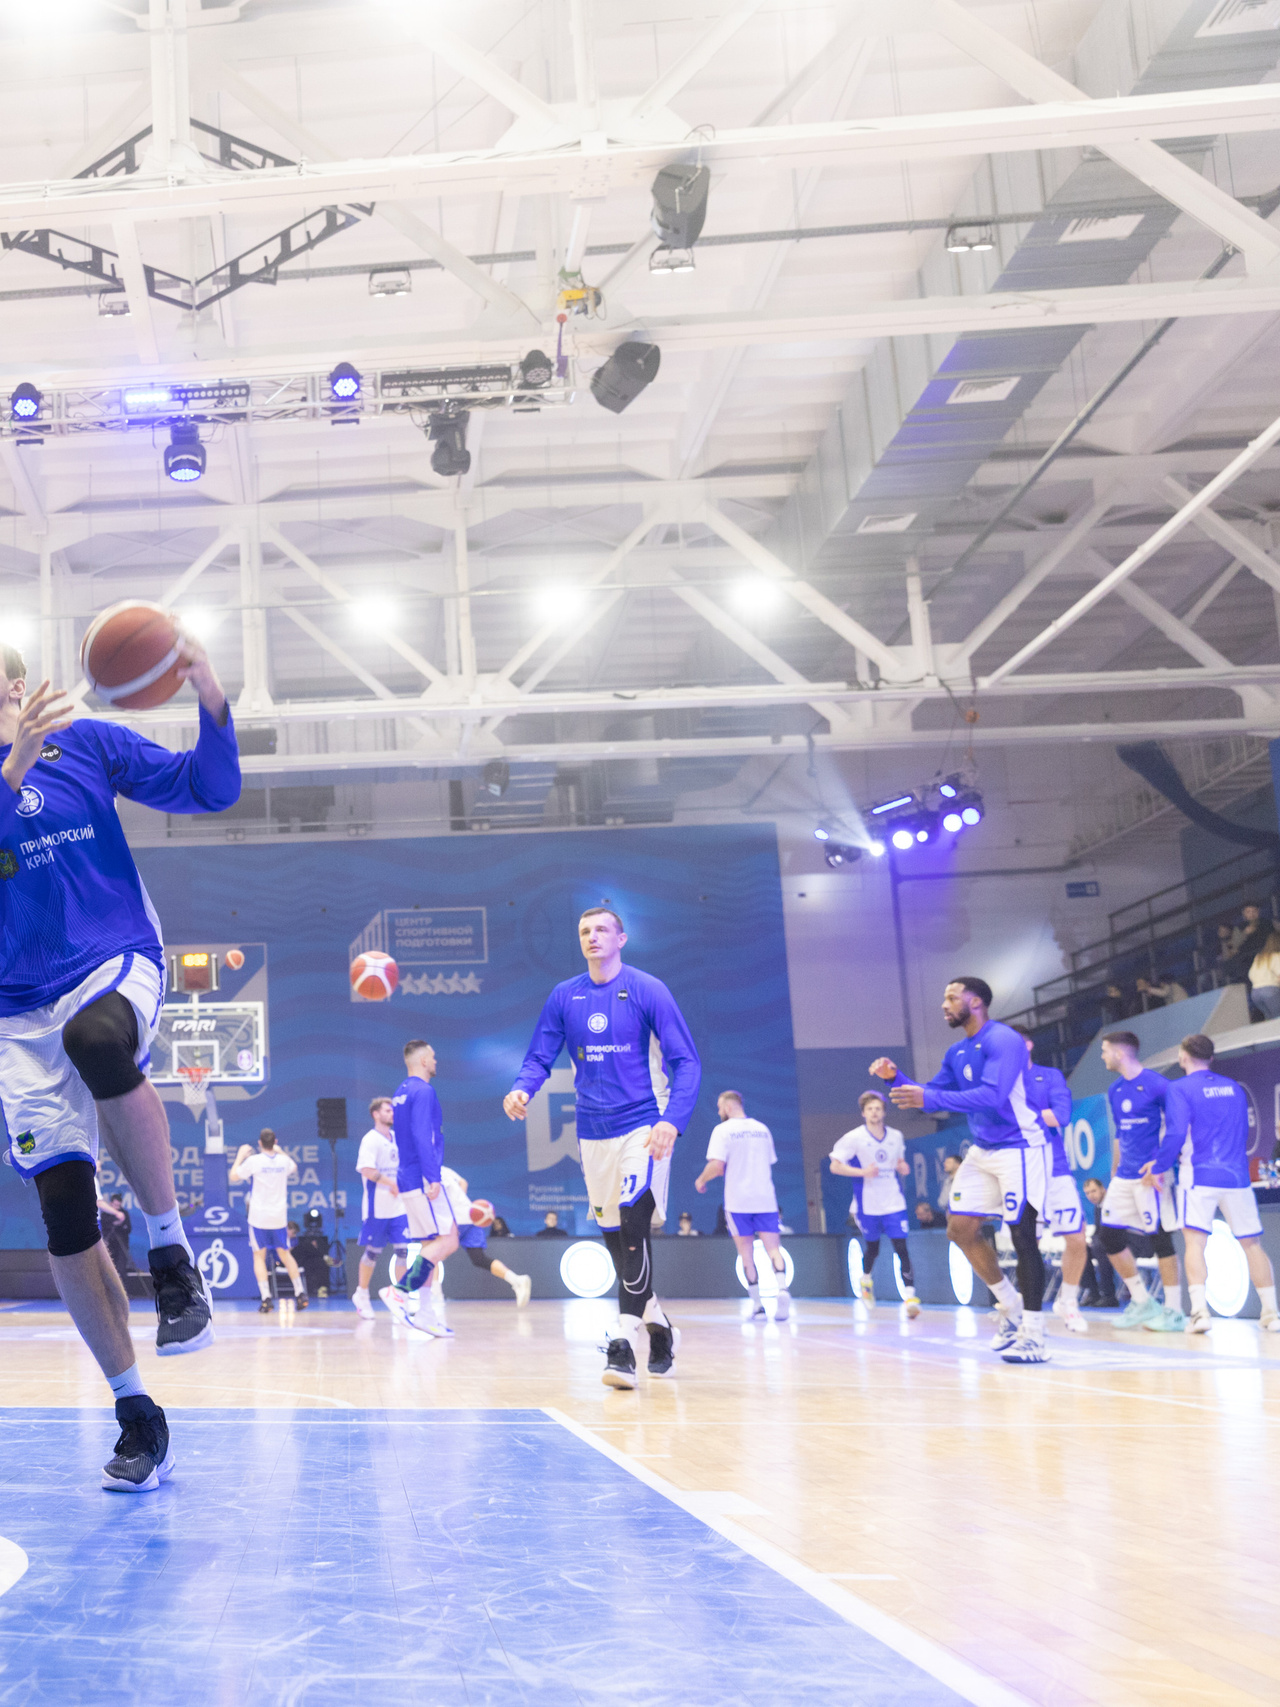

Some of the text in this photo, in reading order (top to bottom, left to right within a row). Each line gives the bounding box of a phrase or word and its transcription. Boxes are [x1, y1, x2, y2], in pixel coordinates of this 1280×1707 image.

[41, 748, 59, 758] РФБ
[19, 824, 95, 855] ПРИМОРСКИЙ
[25, 848, 55, 870] КРАЙ
[395, 917, 432, 926] ЦЕНТР
[395, 925, 473, 937] СПОРТИВНОЙ
[395, 937, 473, 948] ПОДГОТОВКИ
[171, 1019, 217, 1032] PARI
[585, 1043, 631, 1053] ПРИМОРСКИЙ
[586, 1053, 604, 1062] КРАЙ
[1004, 1192, 1017, 1211] 6
[1054, 1208, 1077, 1224] 77
[1143, 1211, 1152, 1225] 3
